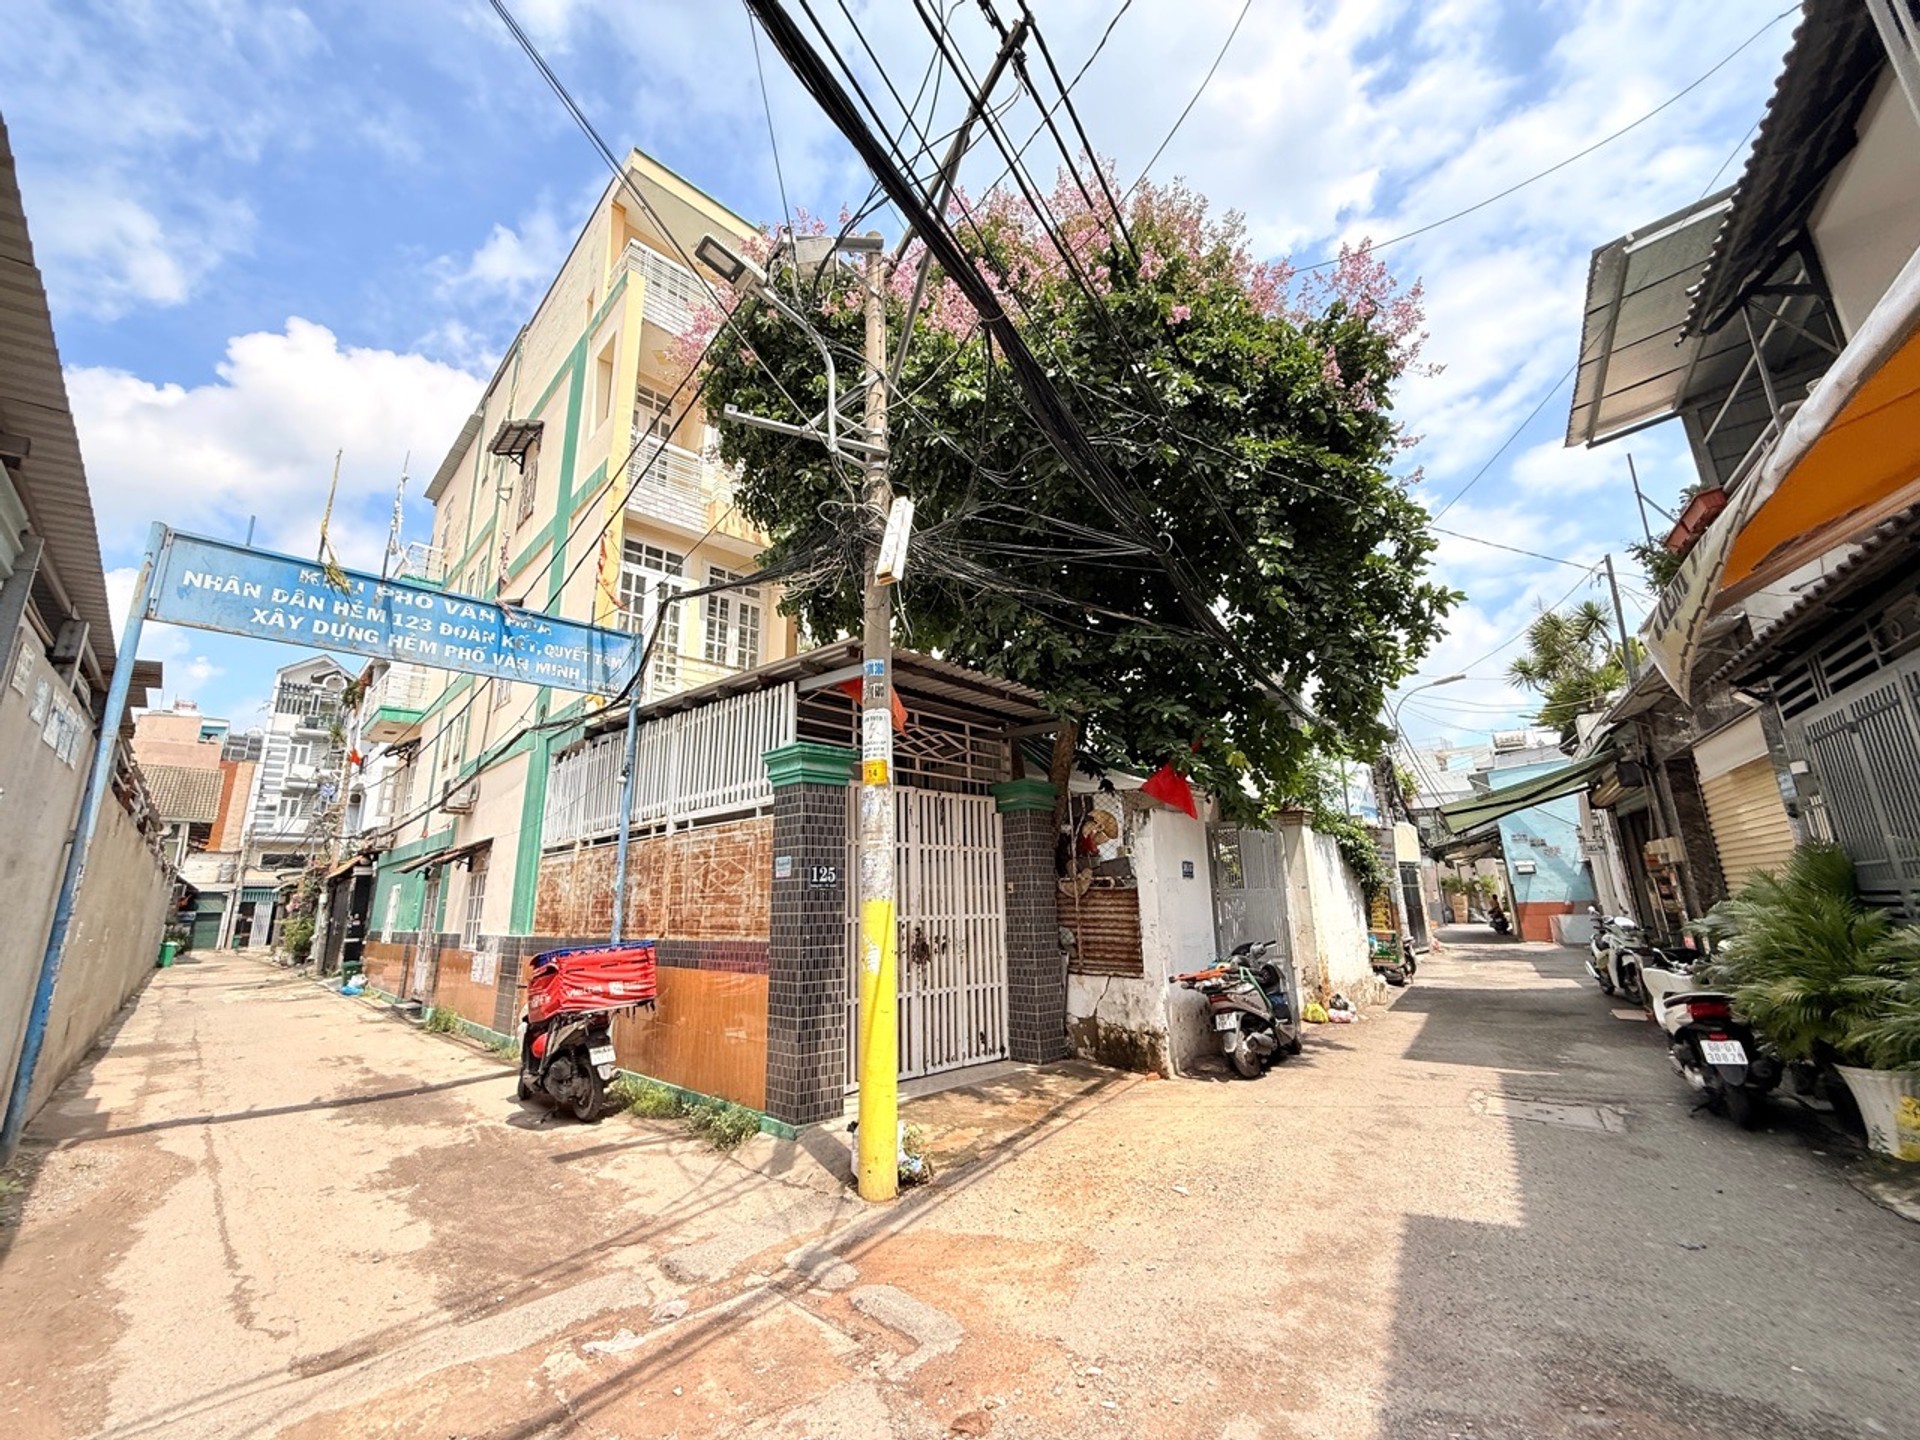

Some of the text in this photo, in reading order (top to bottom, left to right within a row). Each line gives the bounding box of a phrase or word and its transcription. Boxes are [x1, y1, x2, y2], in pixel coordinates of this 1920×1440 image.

[182, 569, 262, 599] NHÂN
[271, 587, 325, 612] DÂN
[392, 613, 433, 633] 123
[439, 621, 496, 645] ĐOÀN
[544, 643, 590, 664] QUYẾT
[250, 606, 306, 631] XÂY
[312, 618, 380, 646] DỰNG
[444, 645, 488, 664] PHỐ
[535, 661, 581, 680] MINH
[811, 866, 836, 883] 125
